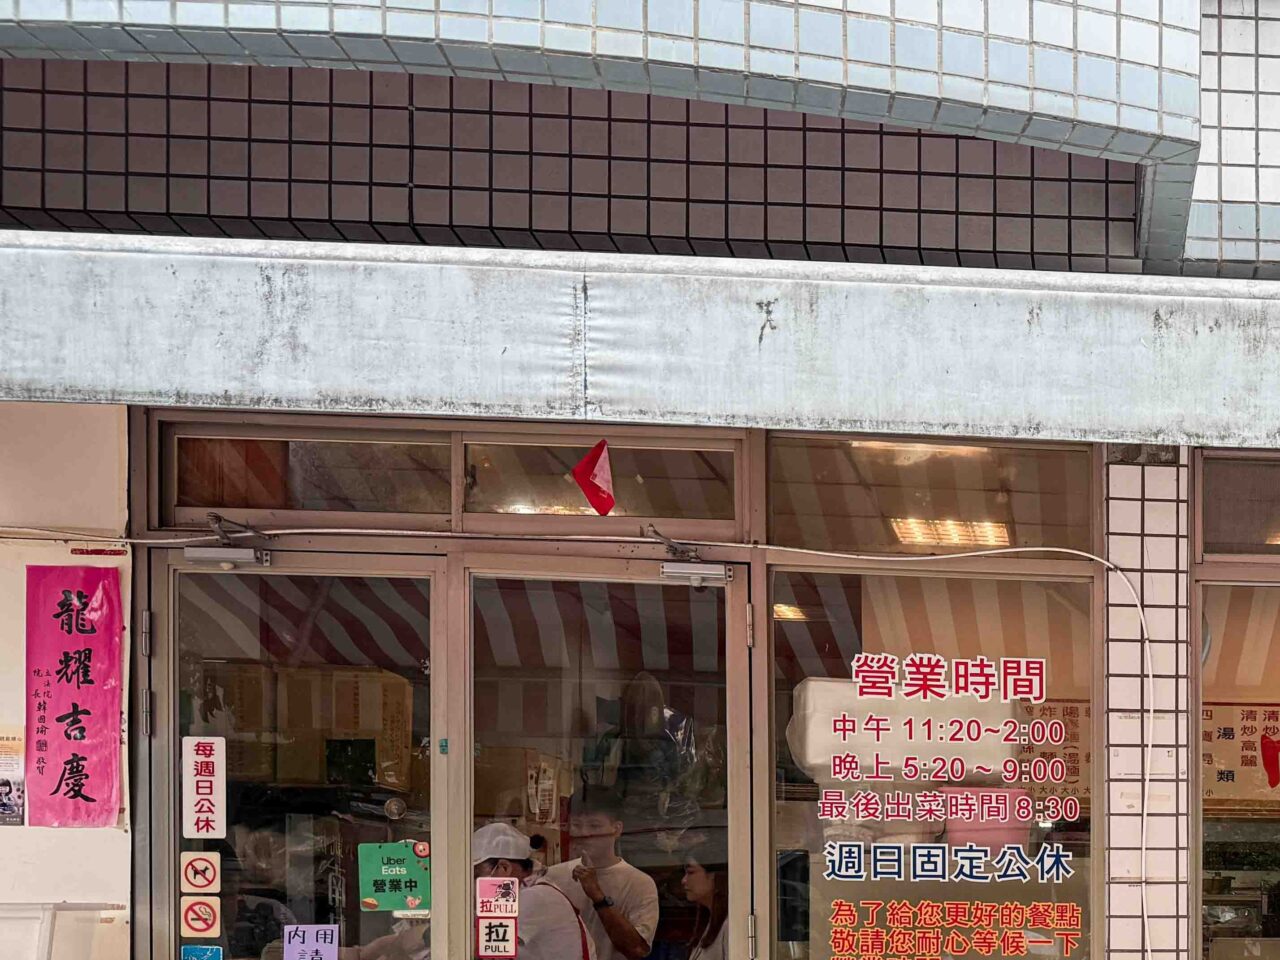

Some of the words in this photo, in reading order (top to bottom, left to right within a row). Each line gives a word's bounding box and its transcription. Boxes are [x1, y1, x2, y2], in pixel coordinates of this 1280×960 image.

[852, 653, 1047, 703] 營業時間
[50, 590, 97, 803] 龍耀吉慶
[832, 713, 891, 743] 中午
[902, 718, 1065, 745] 11:20~2:00
[831, 752, 893, 782] 晚上
[901, 755, 966, 781] 5:20
[1001, 757, 1067, 783] 9:00
[193, 741, 215, 833] 每週日公休
[817, 790, 1008, 822] 最後出菜時間
[1015, 796, 1080, 821] 8:30
[382, 857, 406, 865] Uber
[382, 866, 407, 875] Eats
[822, 842, 1074, 883] 週日固定公休
[373, 879, 418, 893] 營業中
[480, 899, 493, 913] 拉
[494, 904, 516, 914] PULL
[829, 900, 1082, 930] 為了給您更好的餐點
[485, 922, 509, 943] 拉
[829, 929, 1082, 956] 敬請您耐心等候一下
[485, 945, 510, 953] PULL
